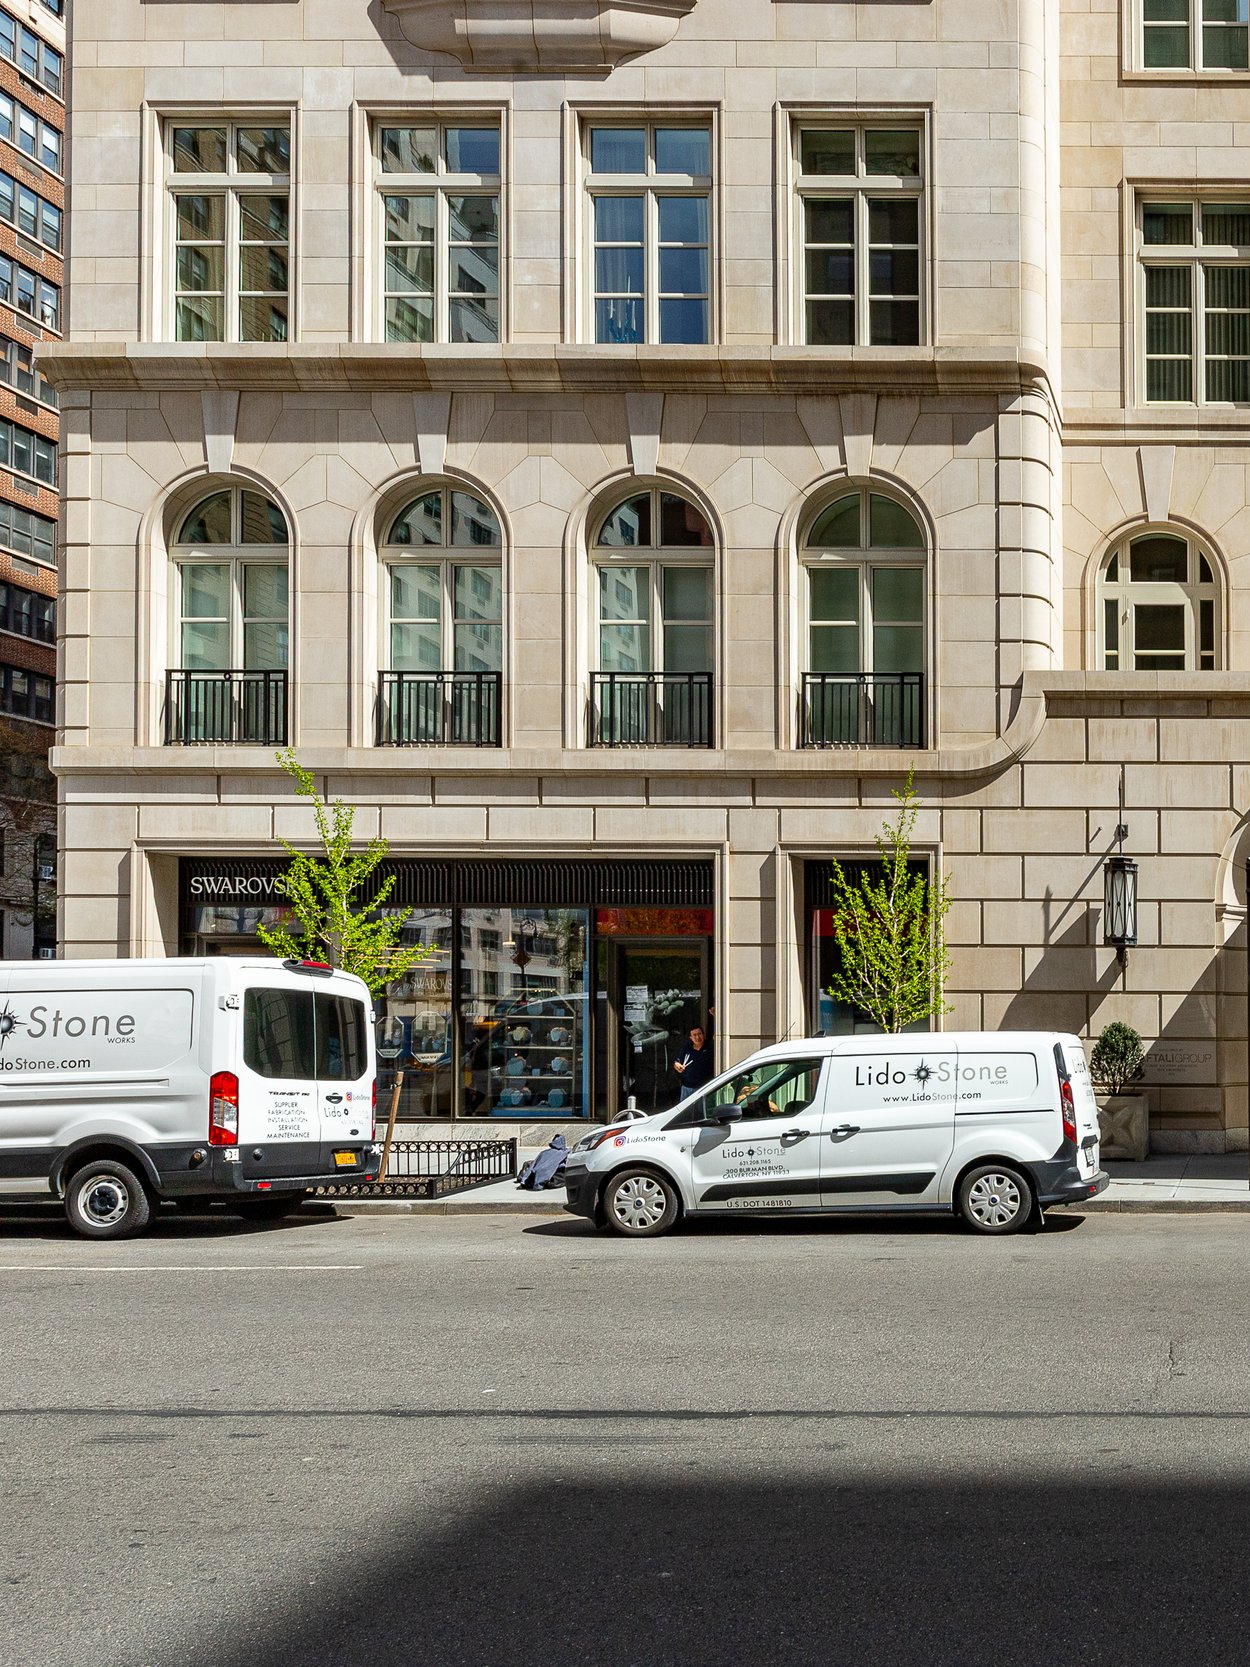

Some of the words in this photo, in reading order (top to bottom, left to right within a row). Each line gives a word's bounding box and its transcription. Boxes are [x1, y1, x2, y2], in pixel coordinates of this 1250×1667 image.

[190, 876, 295, 895] SWAROVS
[410, 977, 452, 991] SWAROVS
[27, 1005, 136, 1039] Stone
[855, 1062, 906, 1086] Lido
[937, 1061, 1008, 1082] Stone
[883, 1091, 982, 1102] www.LidoStone.com
[323, 1106, 343, 1118] Lido
[267, 1116, 309, 1124] INSTALLATION
[626, 1135, 666, 1144] LidoStone
[722, 1148, 745, 1159] Lido
[756, 1146, 786, 1156] Stone
[739, 1166, 768, 1174] BURMAN
